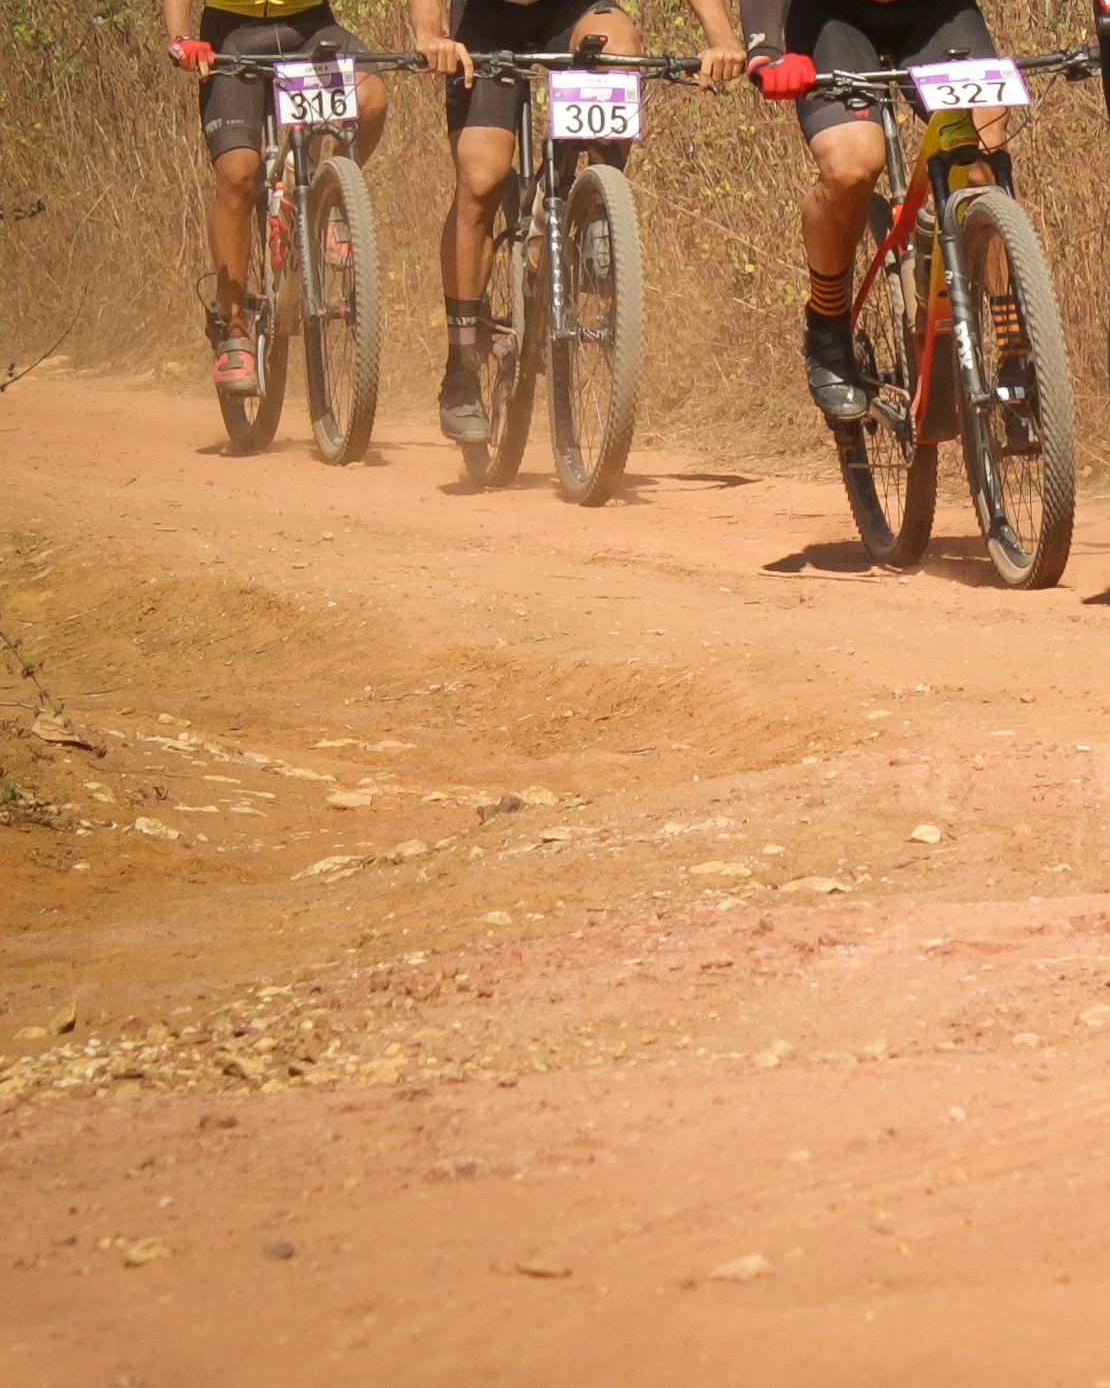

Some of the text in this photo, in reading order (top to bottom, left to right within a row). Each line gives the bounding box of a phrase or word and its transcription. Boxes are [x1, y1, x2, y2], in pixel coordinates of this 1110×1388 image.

[291, 89, 347, 120] 316
[937, 82, 1006, 105] 327
[566, 104, 628, 134] 305
